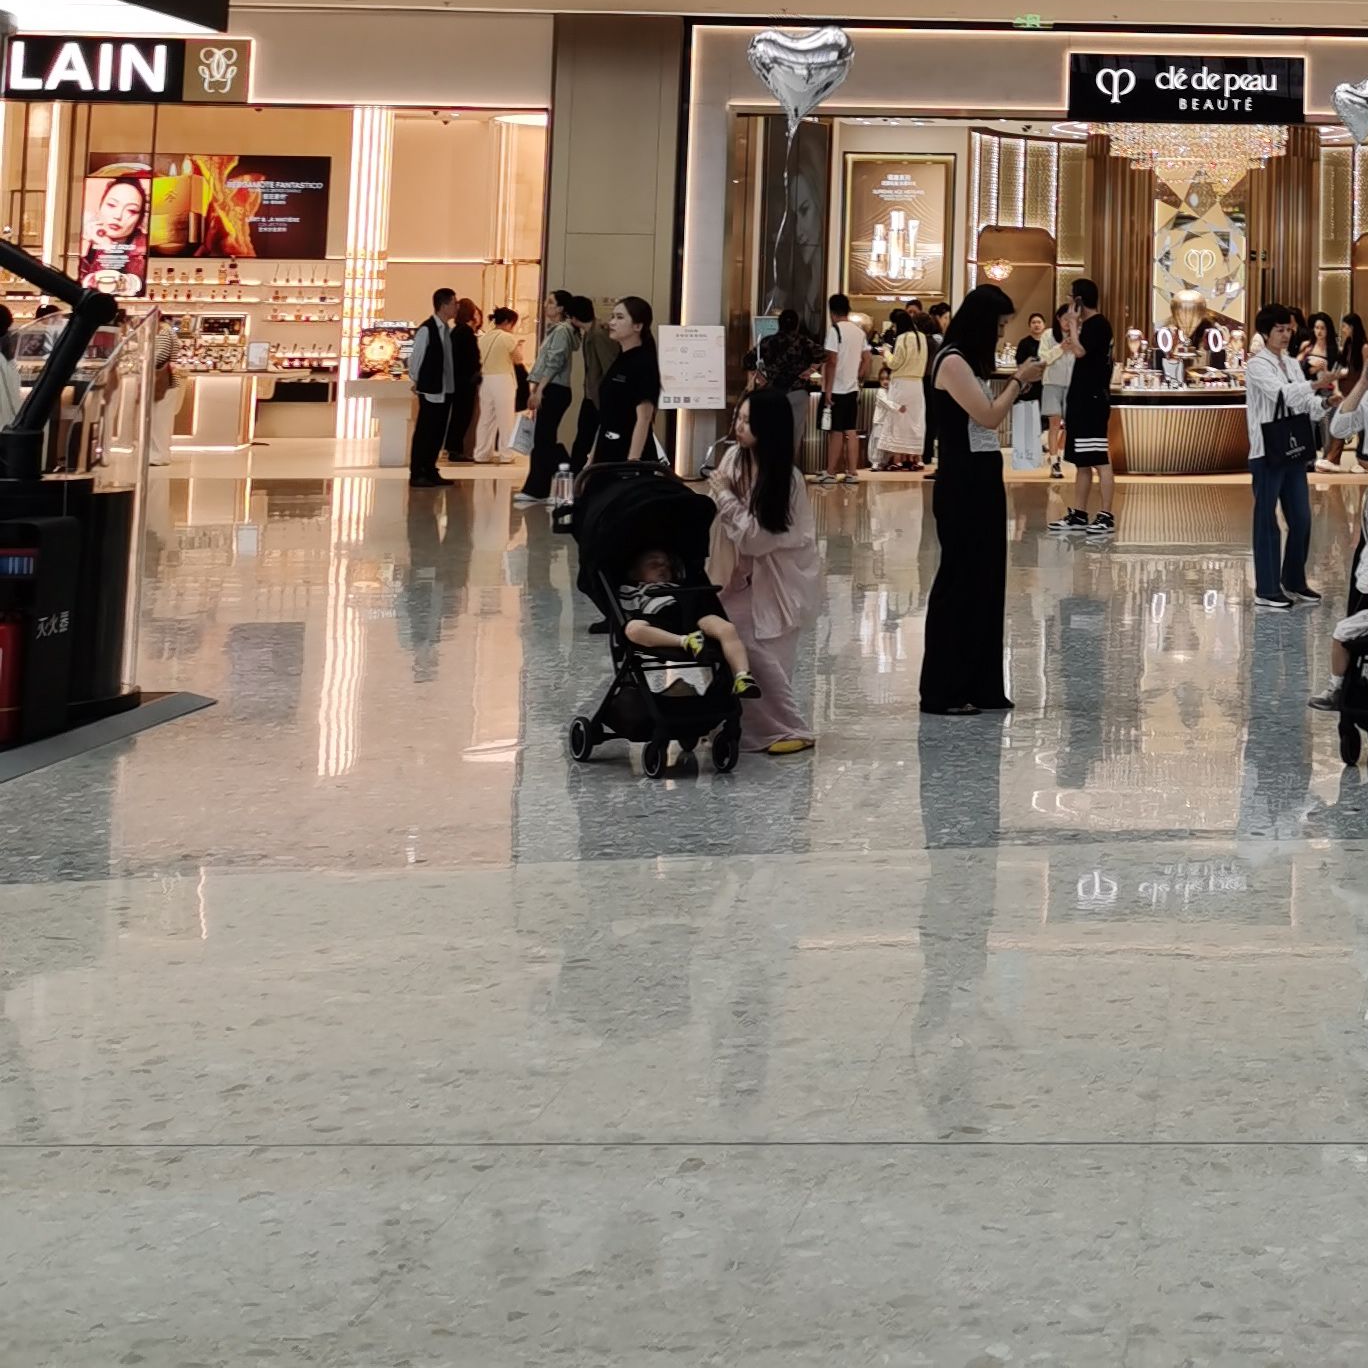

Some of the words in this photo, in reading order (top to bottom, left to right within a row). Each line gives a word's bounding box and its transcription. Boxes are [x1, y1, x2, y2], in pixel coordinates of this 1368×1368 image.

[9, 40, 168, 93] LAIN
[1154, 65, 1188, 90] clé
[1190, 65, 1222, 90] de
[1223, 73, 1278, 98] peau
[1178, 96, 1253, 111] BEAUTÉ
